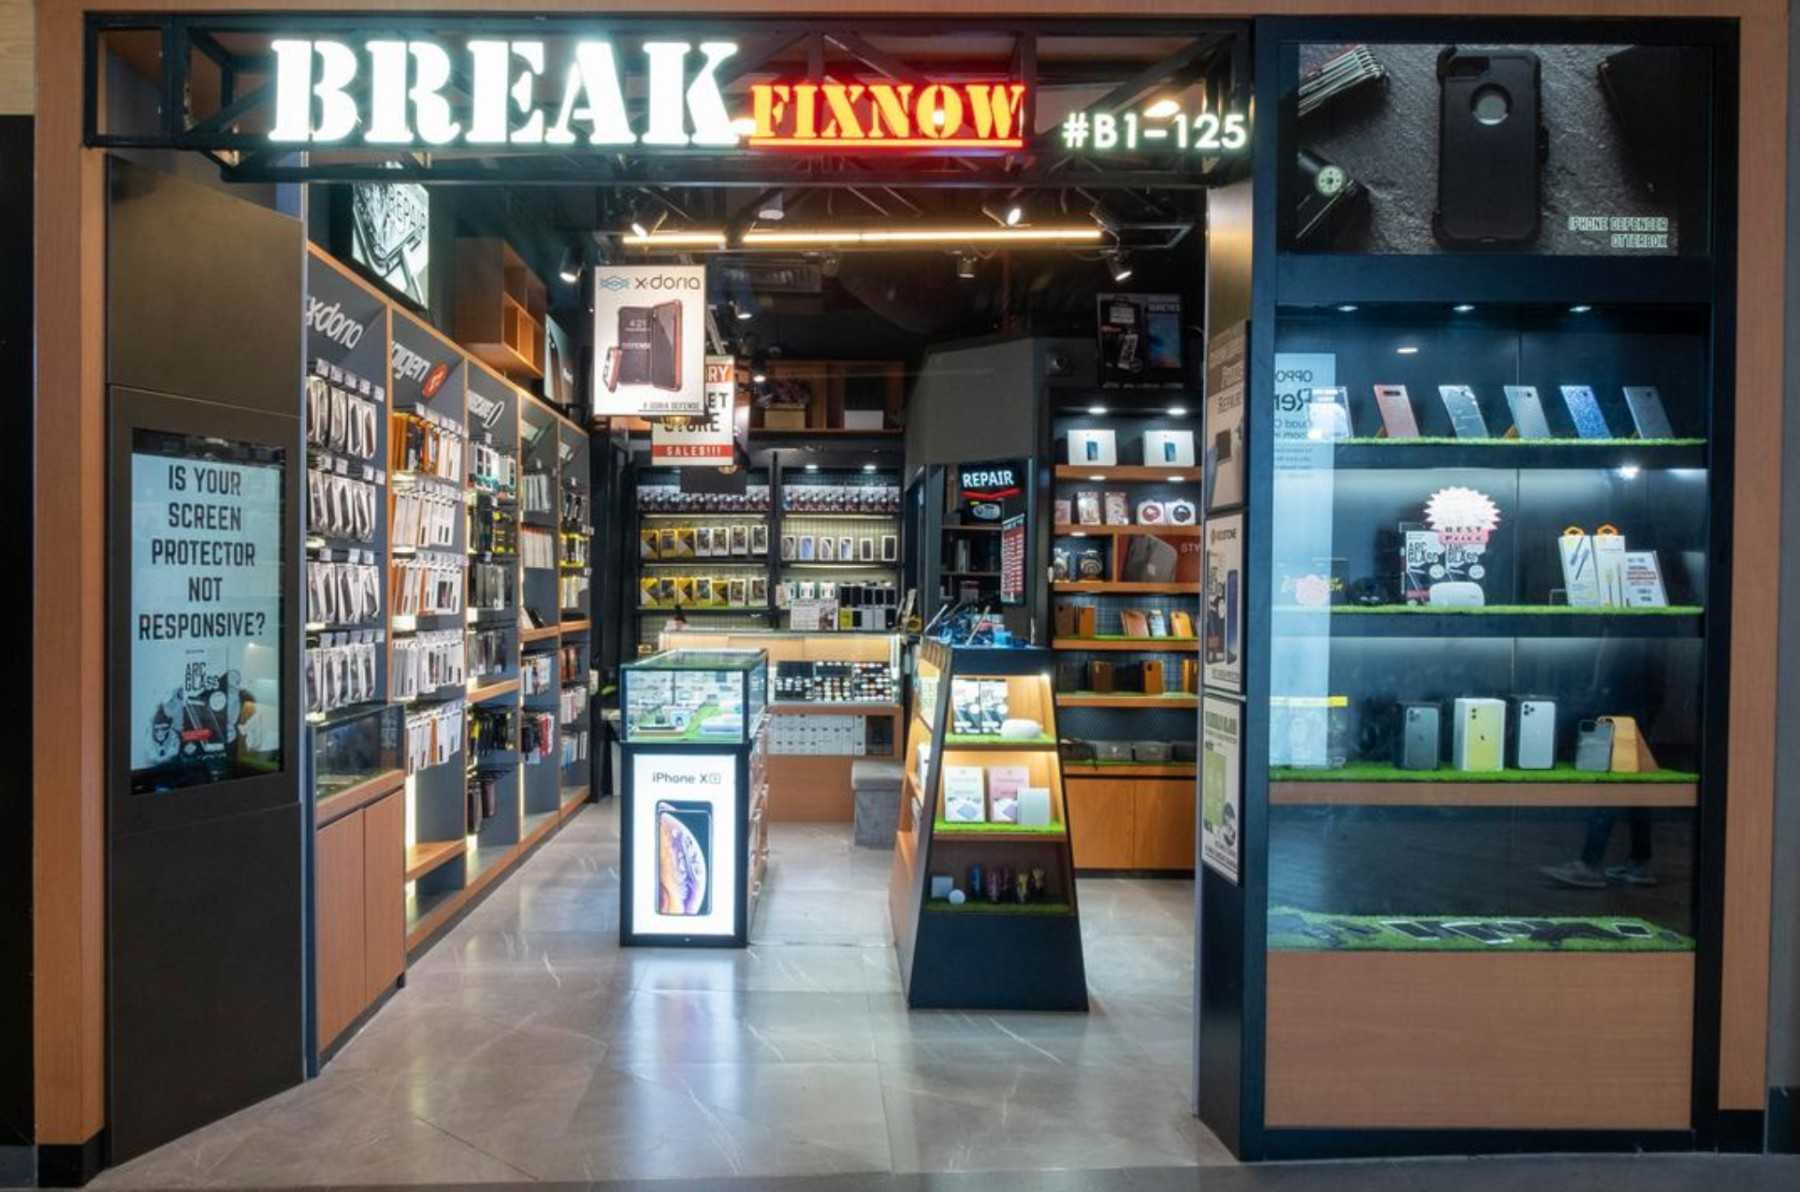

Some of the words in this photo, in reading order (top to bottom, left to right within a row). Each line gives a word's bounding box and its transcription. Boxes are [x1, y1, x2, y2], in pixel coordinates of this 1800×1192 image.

[268, 39, 739, 145] BREAK
[750, 84, 1025, 139] FIXNOW
[1062, 112, 1247, 150] #B1-125
[168, 464, 187, 492] IS
[193, 467, 242, 496] YOUR
[962, 470, 1015, 488] REPAIR
[168, 502, 242, 531] SCREEN
[151, 538, 256, 567] PROTECTOR
[188, 576, 223, 602] NOT
[138, 611, 266, 641] RESPONSIVE?
[652, 771, 696, 784] iPhone
